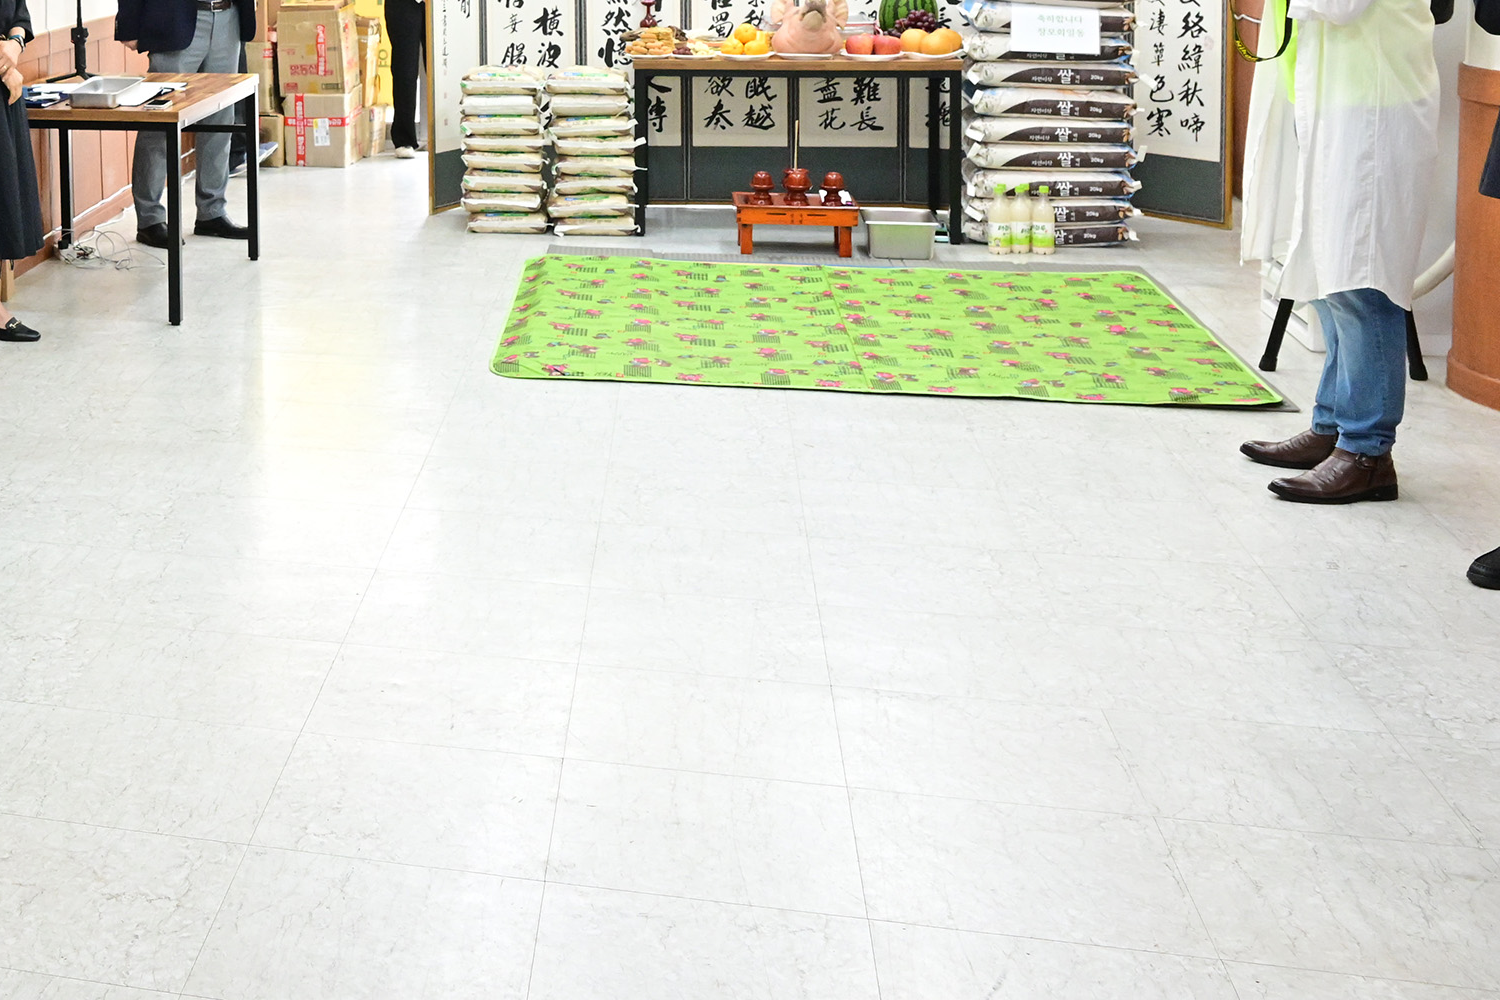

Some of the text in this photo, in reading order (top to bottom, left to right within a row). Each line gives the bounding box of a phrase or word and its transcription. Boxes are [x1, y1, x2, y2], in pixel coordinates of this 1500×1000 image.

[1057, 69, 1074, 84] 쌀
[1057, 101, 1073, 116] 쌀
[1055, 127, 1072, 142] 쌀
[1057, 152, 1074, 167] 쌀
[1056, 181, 1073, 196] 쌀
[1054, 207, 1069, 222] 쌀
[1055, 230, 1067, 244] 쌀
